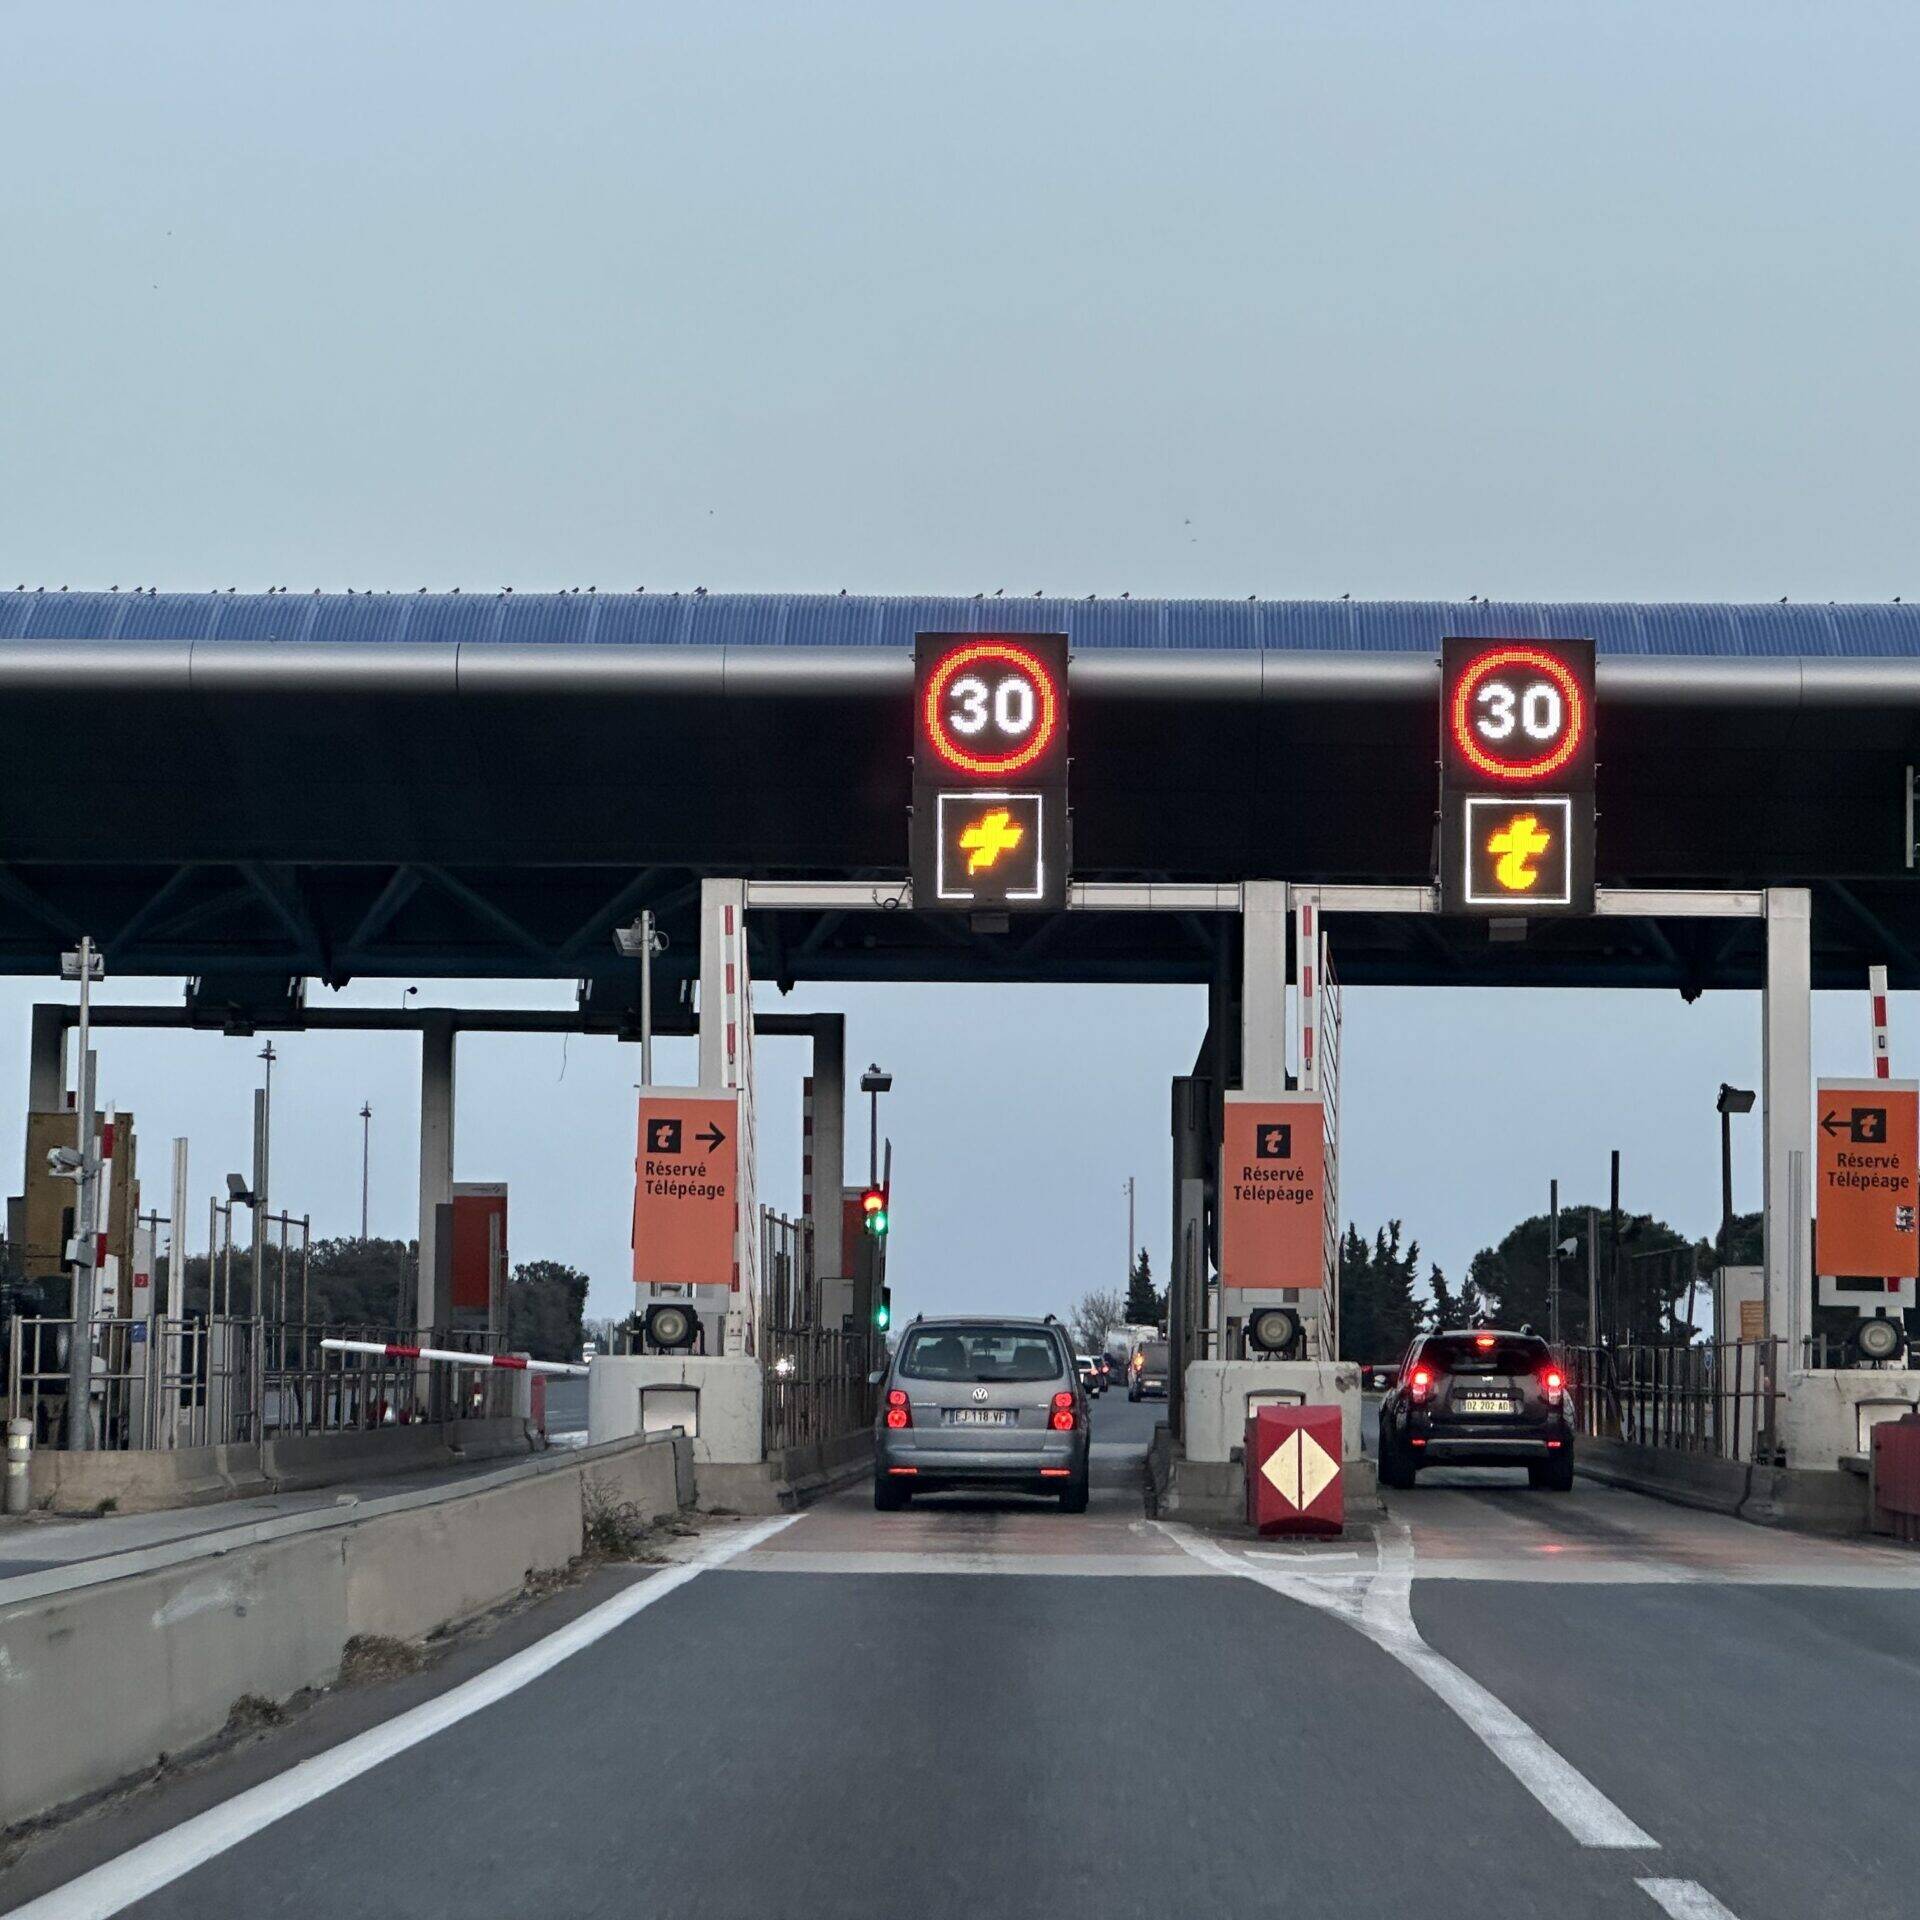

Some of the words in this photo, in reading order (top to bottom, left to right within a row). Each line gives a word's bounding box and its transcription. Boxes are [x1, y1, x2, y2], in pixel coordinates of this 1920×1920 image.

[950, 676, 1034, 735] 30
[1477, 682, 1561, 740] 30
[645, 1160, 706, 1177] Réservé
[1837, 1152, 1900, 1169] Réservé
[1243, 1166, 1304, 1181] Réservé
[1828, 1171, 1910, 1192] Télépéage
[646, 1179, 725, 1200] Télépéage
[1233, 1185, 1314, 1205] Télépéage
